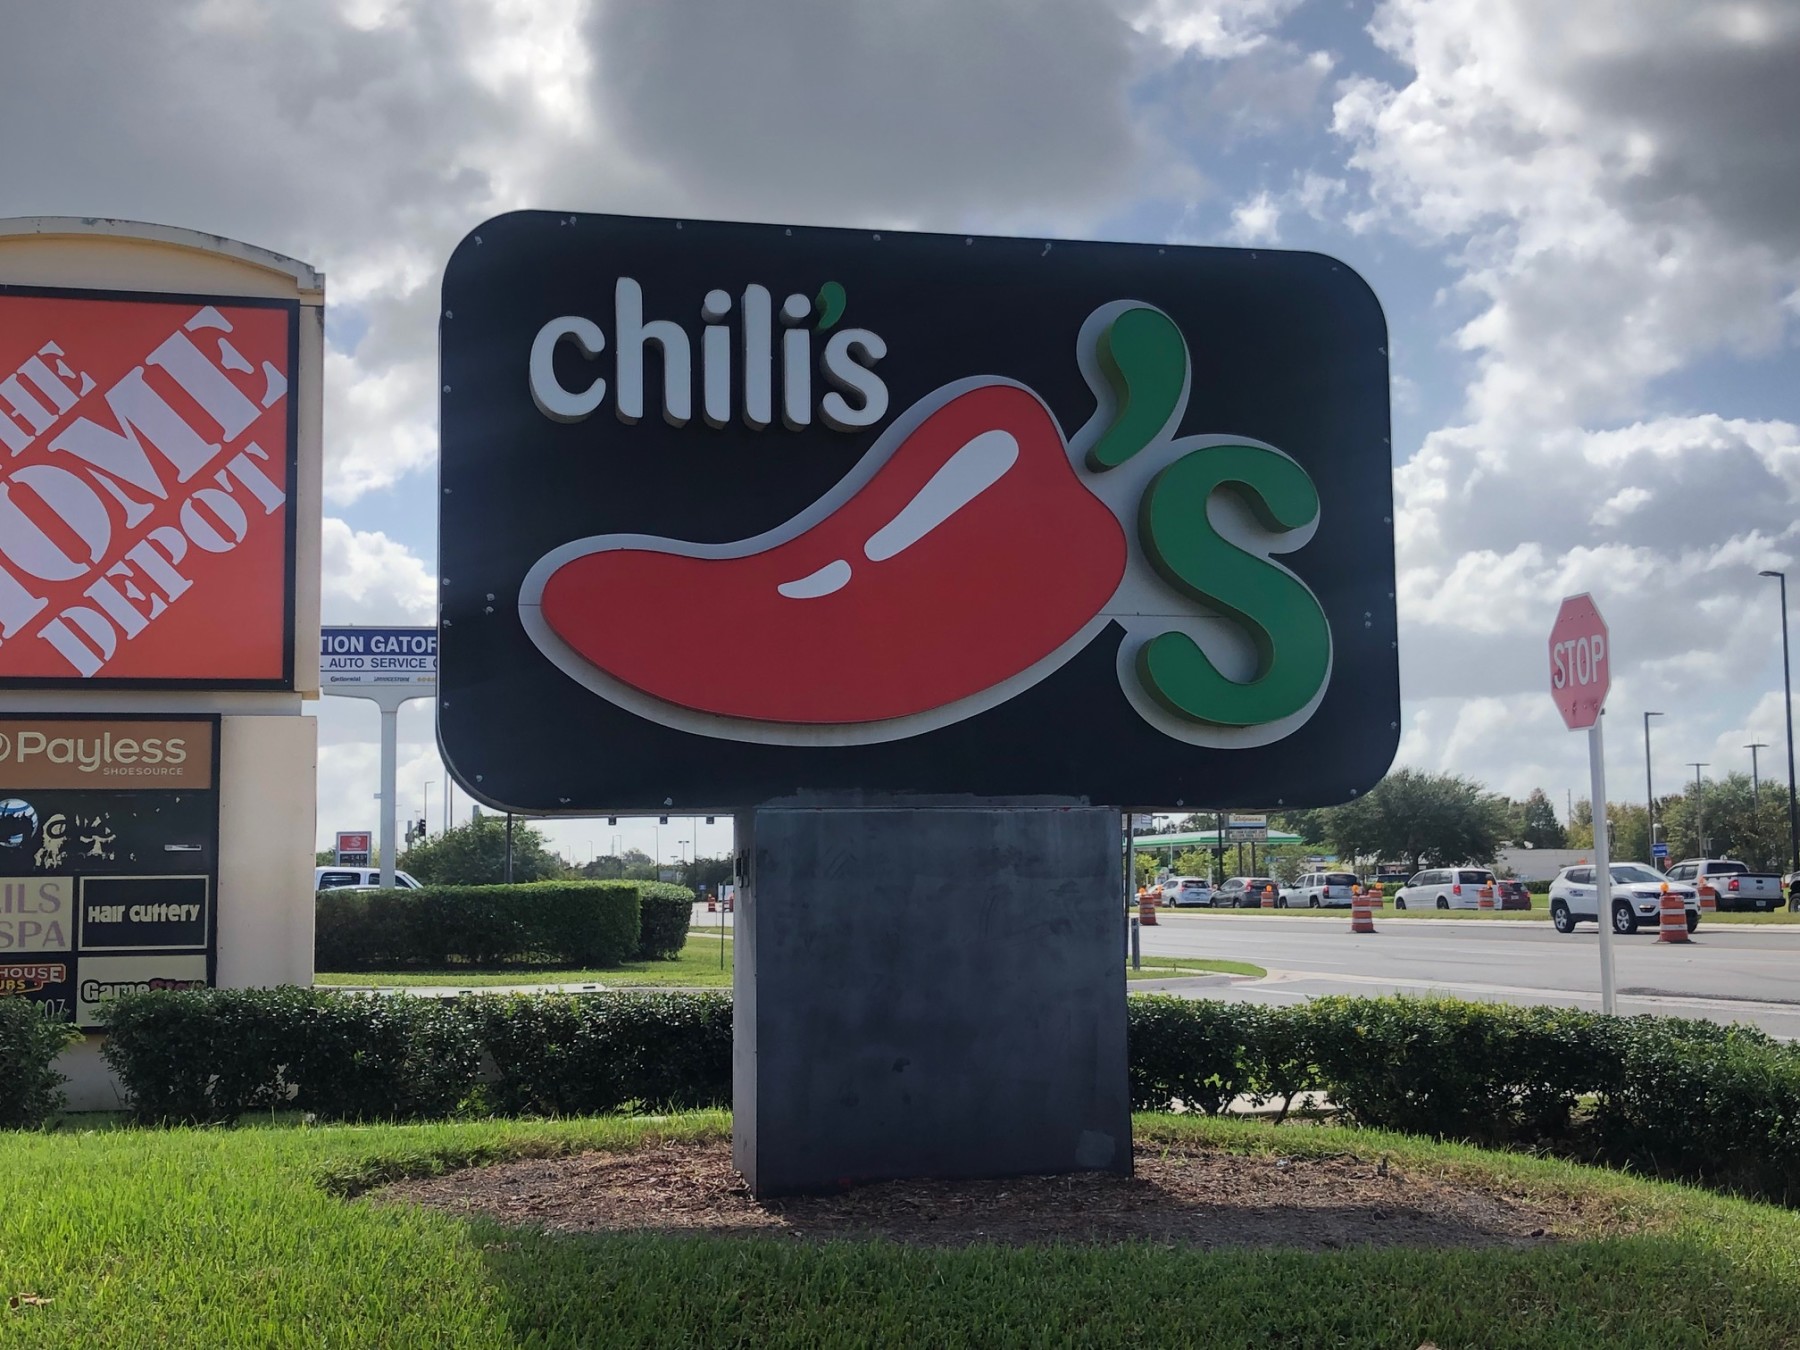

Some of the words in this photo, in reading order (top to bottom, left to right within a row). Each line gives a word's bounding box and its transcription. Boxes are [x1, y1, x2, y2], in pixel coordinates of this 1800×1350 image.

[530, 276, 889, 428] chili's
[0, 340, 97, 458] HE
[36, 441, 286, 678] DEPOT
[329, 657, 365, 668] AUTO
[370, 657, 427, 669] SERVICE
[1553, 634, 1604, 689] STOP
[17, 731, 187, 772] Payless
[103, 767, 184, 776] SHOESOURCE
[0, 883, 61, 914] ILS
[87, 905, 126, 923] Hair
